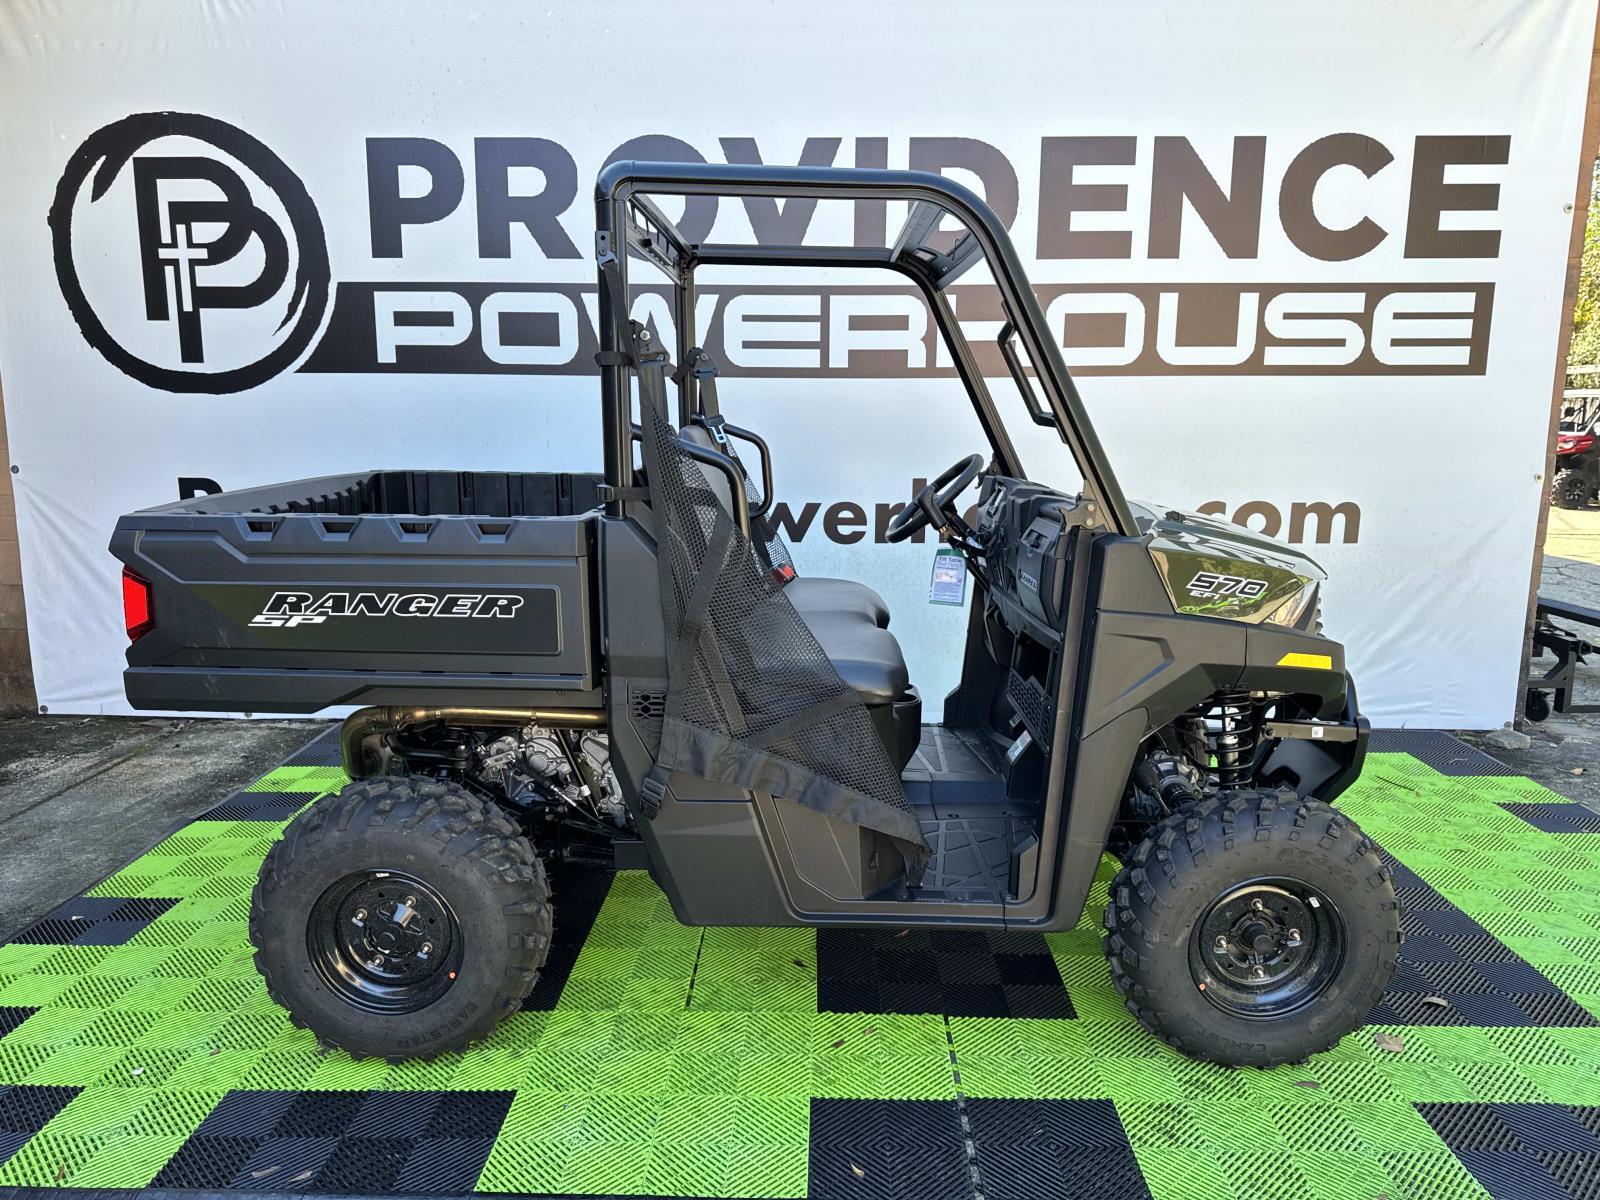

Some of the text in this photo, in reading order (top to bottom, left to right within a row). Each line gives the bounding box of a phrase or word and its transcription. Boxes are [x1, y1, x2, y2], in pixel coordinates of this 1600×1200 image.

[366, 132, 1511, 262] PROVIDENCE
[374, 290, 1478, 369] POWERHOUSE
[1186, 571, 1269, 598] 570
[1189, 590, 1221, 600] EFI
[263, 592, 524, 618] RANGER
[248, 615, 327, 627] SP
